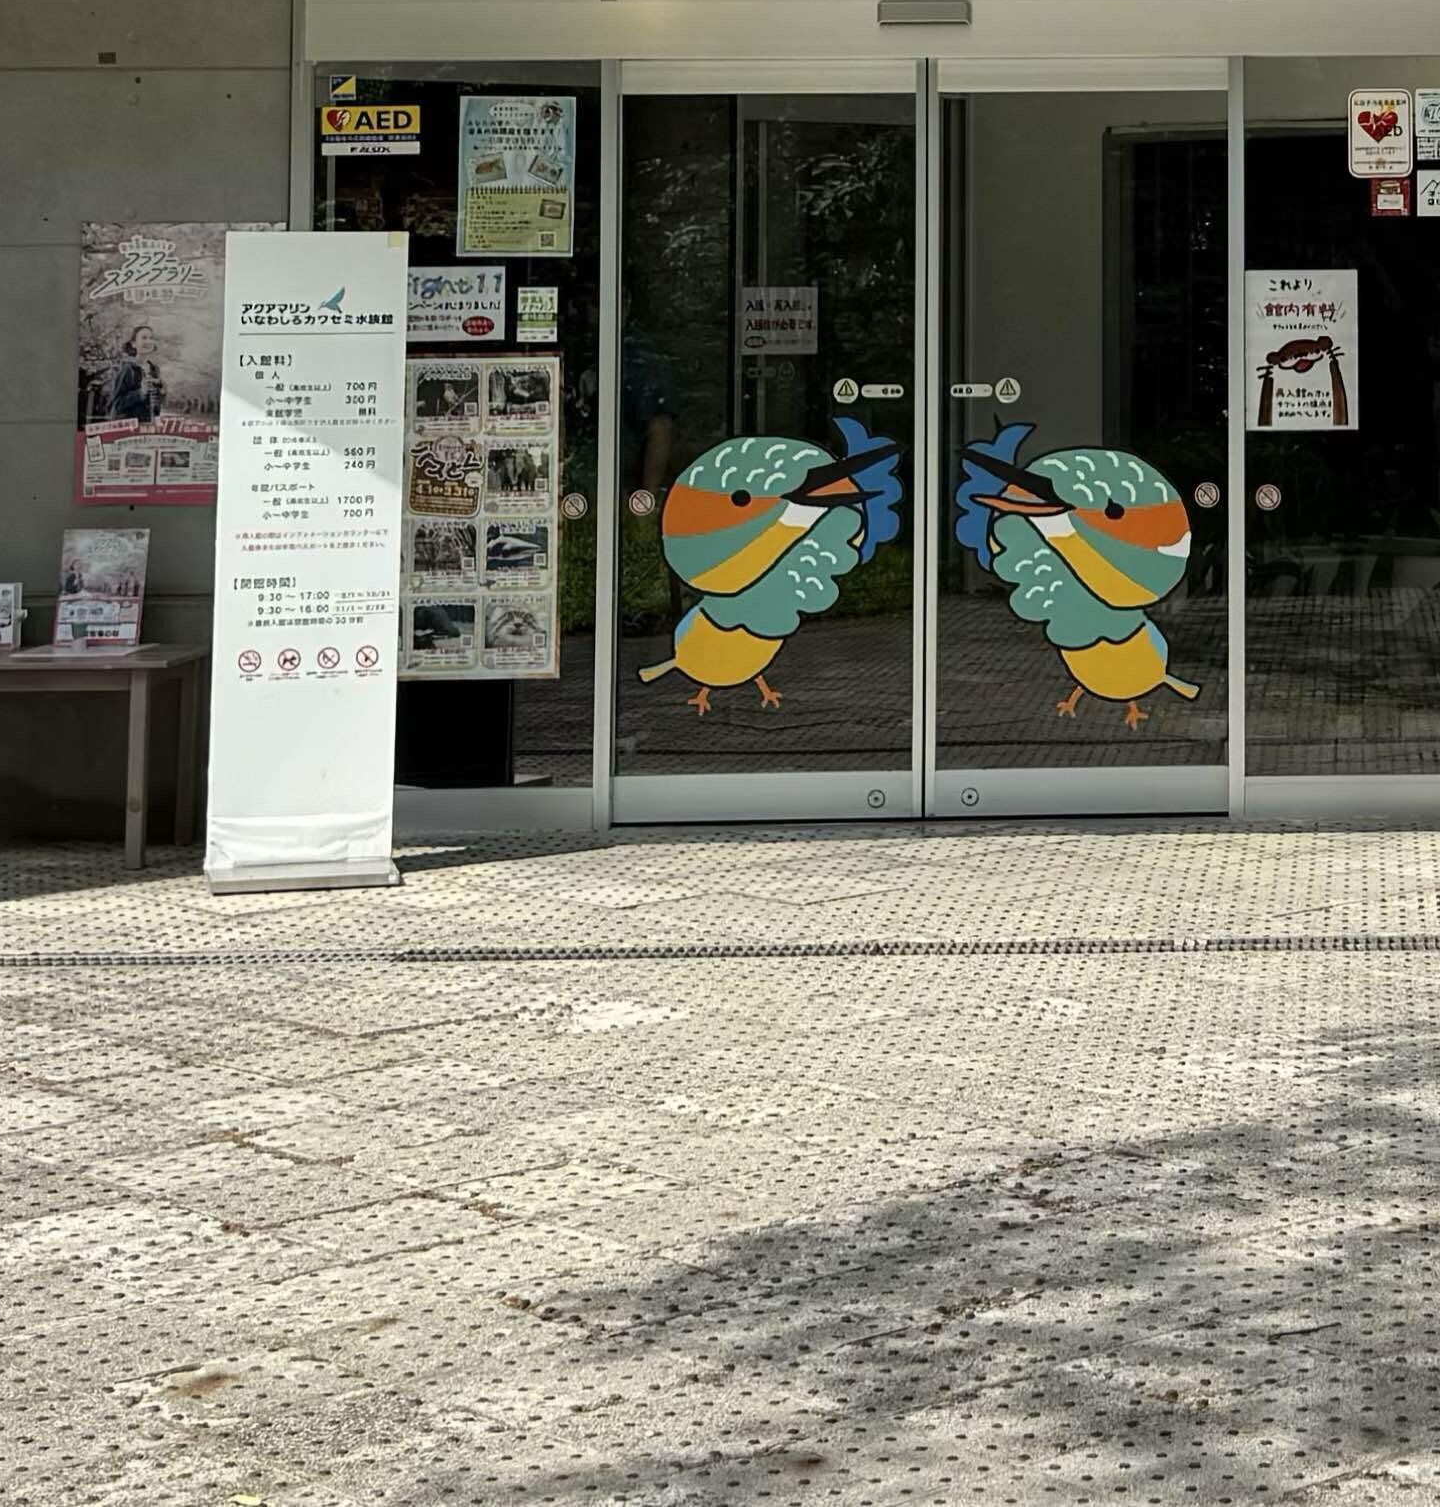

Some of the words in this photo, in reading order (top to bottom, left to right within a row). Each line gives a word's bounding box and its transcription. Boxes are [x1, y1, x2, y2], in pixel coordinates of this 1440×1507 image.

[354, 110, 412, 130] AED
[1269, 278, 1313, 291] これより
[241, 303, 310, 314] アクアマリン
[241, 314, 393, 325] いなわしろカワセミ水族館
